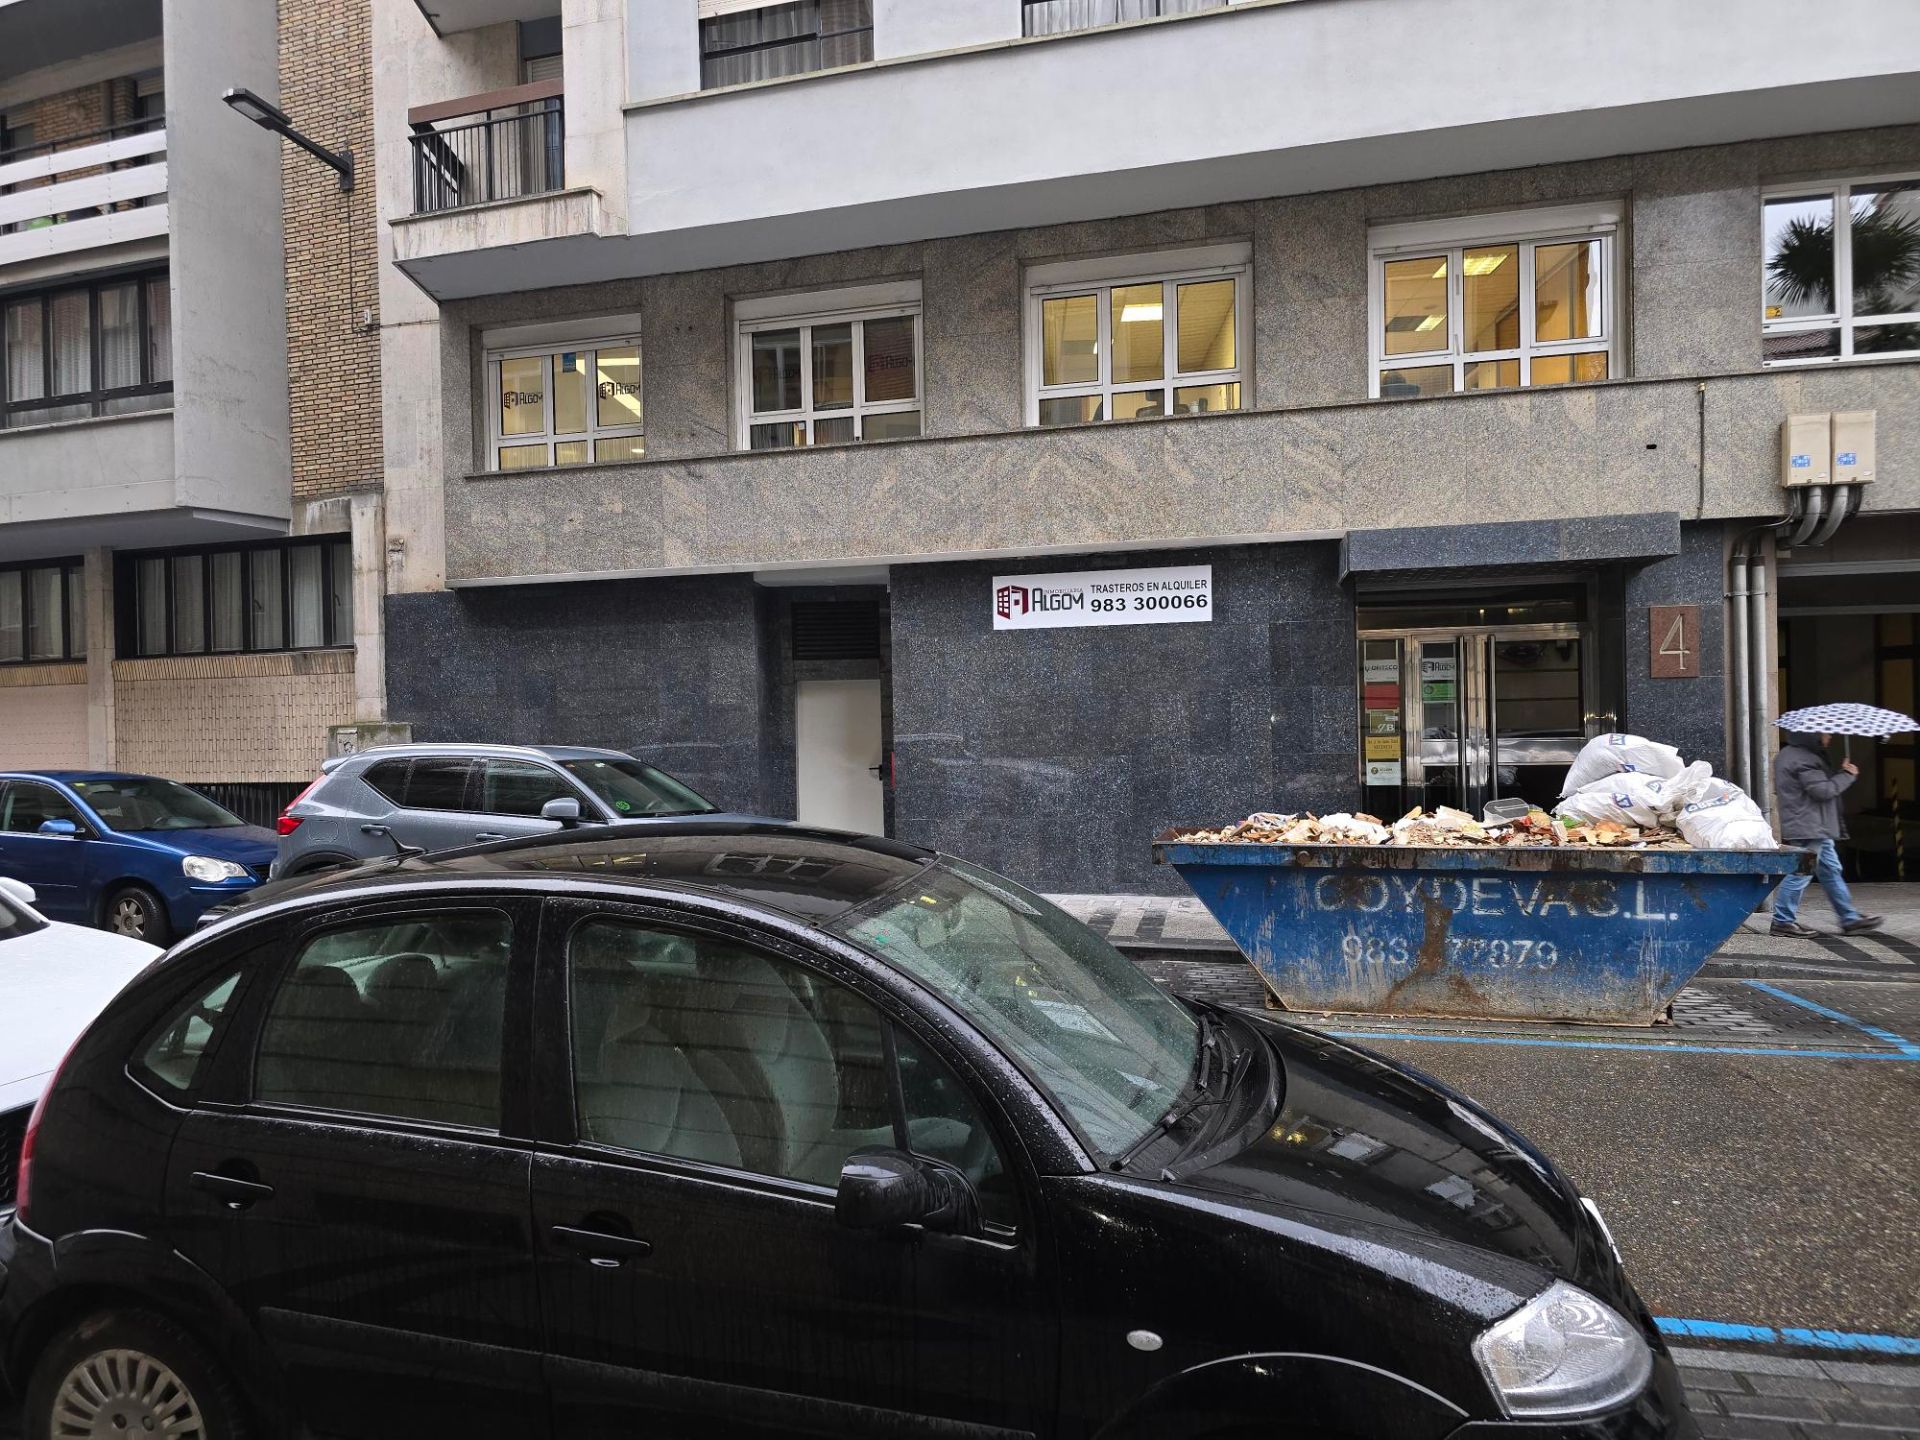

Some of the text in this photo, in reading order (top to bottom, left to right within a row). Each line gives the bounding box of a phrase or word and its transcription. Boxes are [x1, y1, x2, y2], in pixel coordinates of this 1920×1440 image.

[1090, 579, 1208, 593] TRASTEROS EN ALQUILER
[1032, 588, 1084, 612] ALGOM
[1091, 594, 1208, 612] 983 300066
[1659, 613, 1690, 671] 4
[1341, 935, 1409, 964] 983
